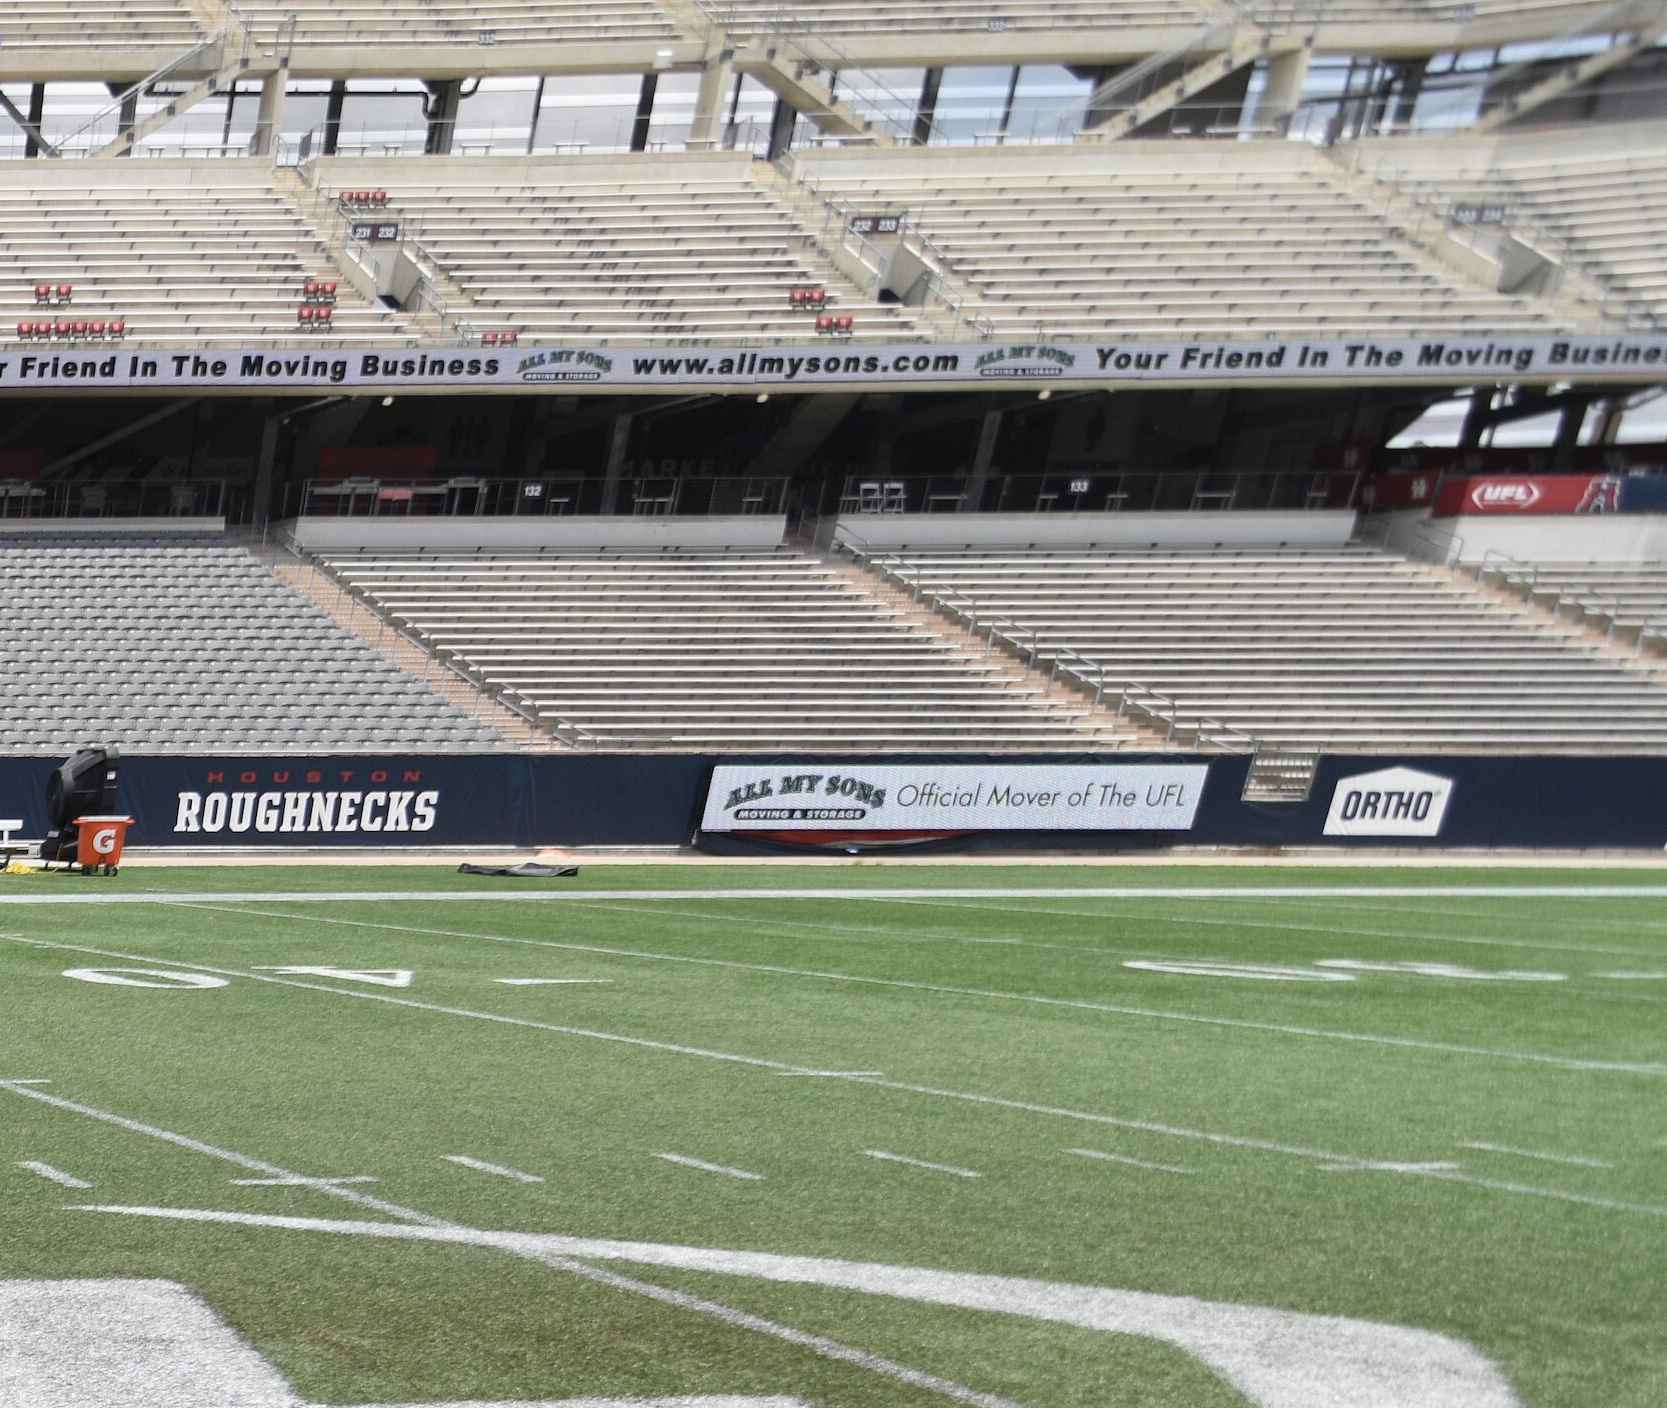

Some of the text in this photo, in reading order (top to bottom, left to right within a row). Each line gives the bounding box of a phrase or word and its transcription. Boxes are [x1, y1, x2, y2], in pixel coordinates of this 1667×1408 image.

[355, 228, 394, 238] 231 232
[19, 356, 116, 378] Friend
[129, 356, 156, 377] In
[172, 356, 227, 378] The
[240, 355, 345, 382] Moving
[359, 355, 498, 376] Business
[632, 353, 960, 379] www.allmysons.com
[1096, 348, 1168, 370] Your
[1179, 346, 1285, 369] Friend
[1297, 345, 1329, 368] In
[1345, 344, 1403, 367] The
[1416, 344, 1534, 371] Moving
[524, 485, 543, 497] 132
[1483, 484, 1527, 501] UFL
[207, 770, 421, 784] HOUSTON
[723, 774, 1185, 810] ALL MY SONS Official Mover of The UFL
[173, 789, 440, 834] ROUGHNECKS
[738, 809, 861, 819] MOVING & STORAGE
[1340, 790, 1433, 822] ORTHO
[93, 829, 117, 854] G
